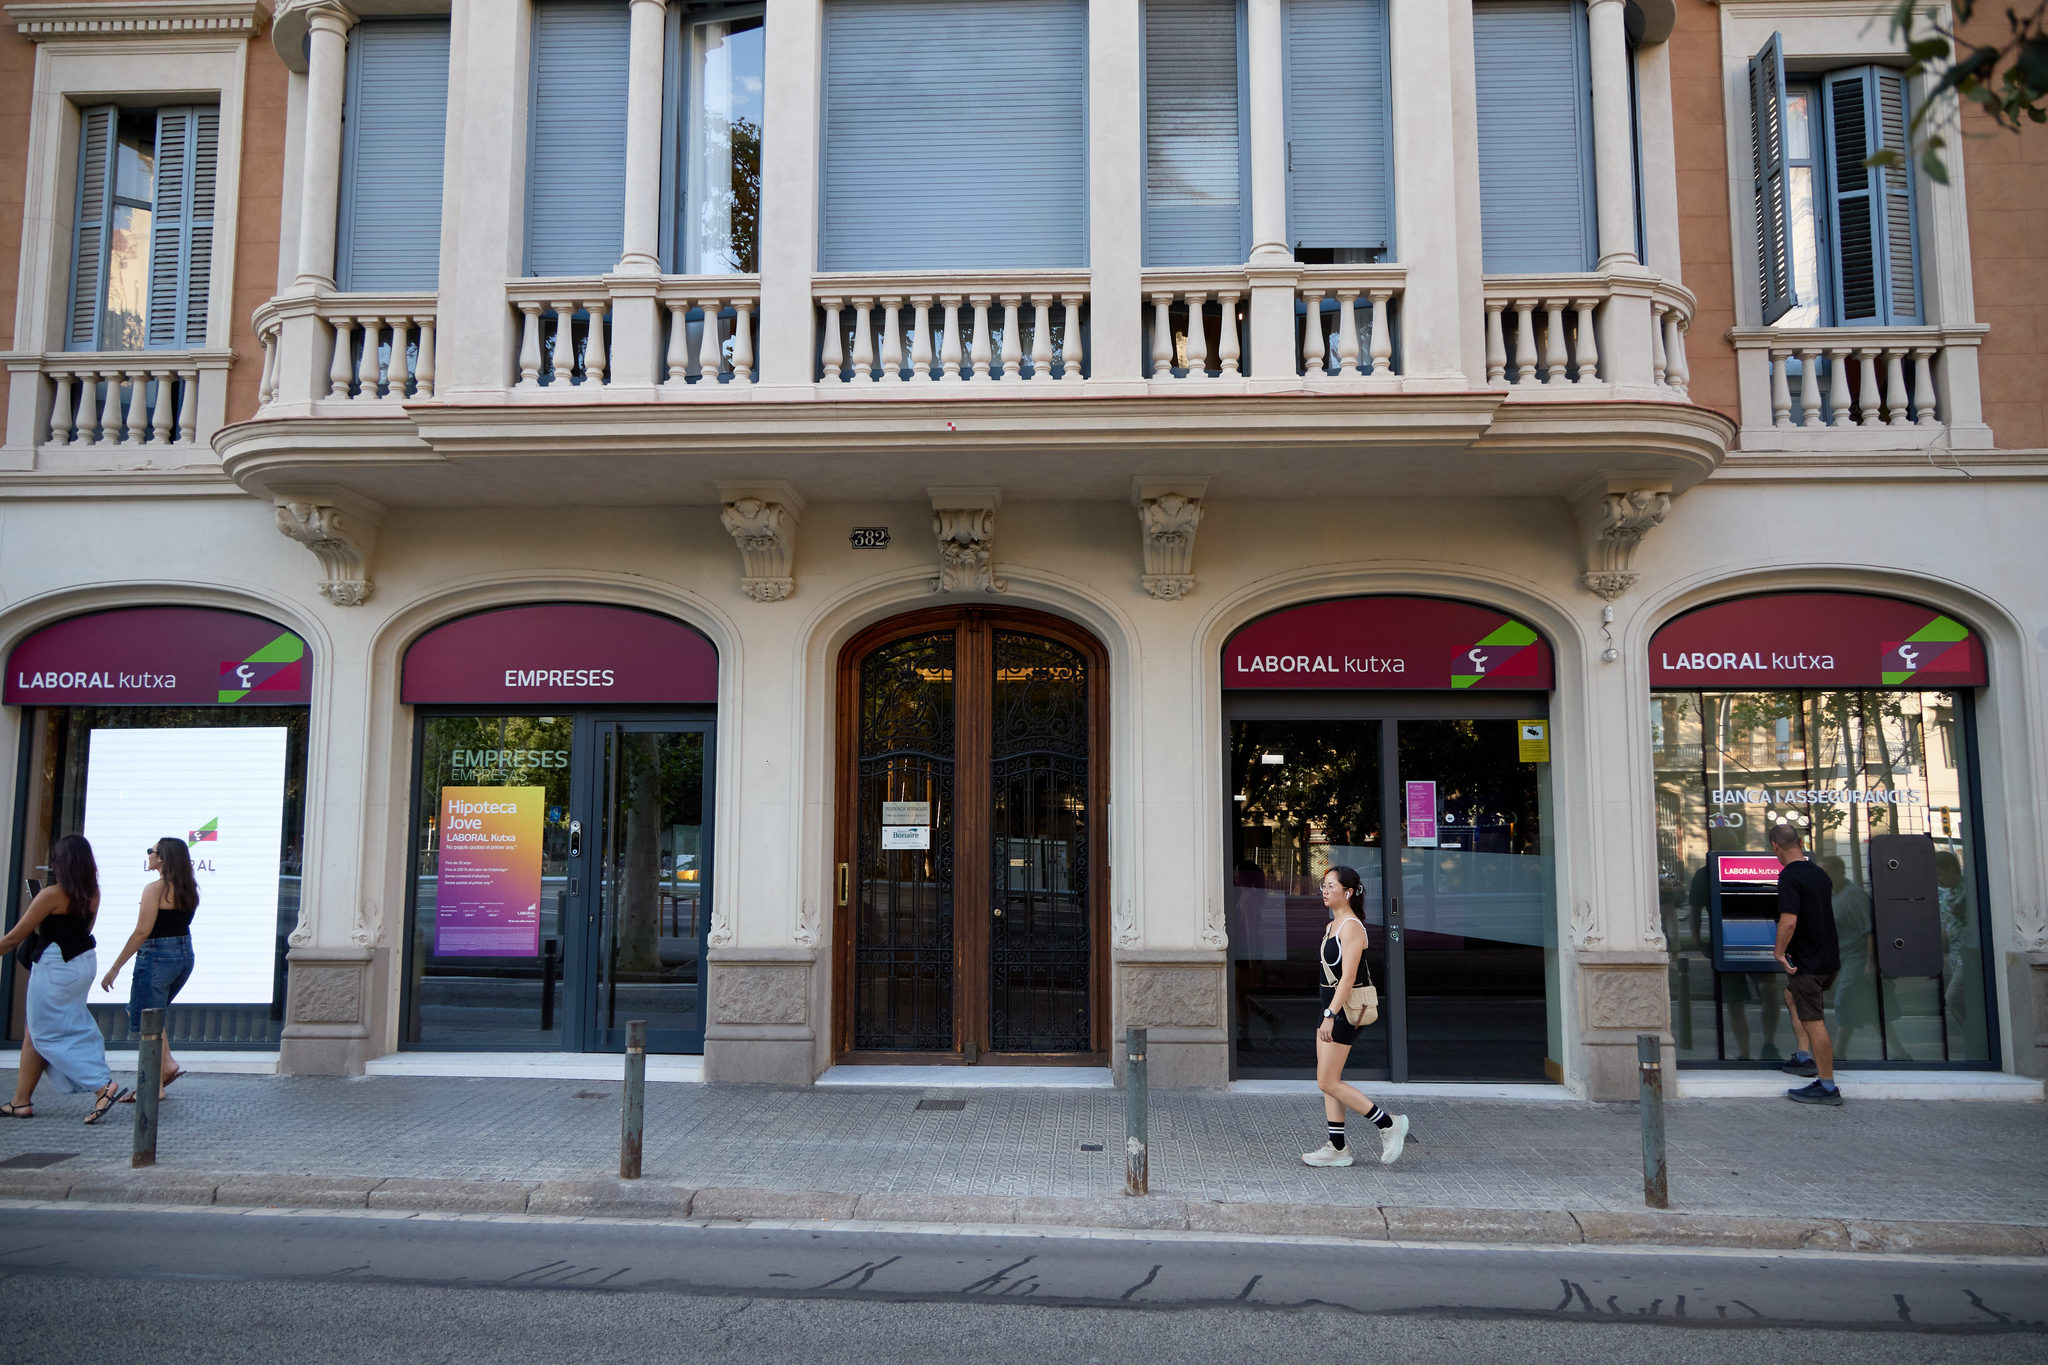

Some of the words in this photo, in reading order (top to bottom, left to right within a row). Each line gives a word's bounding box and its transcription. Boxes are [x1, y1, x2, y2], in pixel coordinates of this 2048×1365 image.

[855, 531, 885, 546] 382
[1237, 655, 1339, 673] LABORAL
[1344, 655, 1405, 673] kutxa
[1662, 652, 1767, 670] LABORAL
[1772, 652, 1835, 670] kutxa
[18, 672, 114, 689] LABORAL
[119, 671, 176, 689] kutxa
[505, 670, 615, 687] EMPRESES
[452, 750, 568, 768] EMPRESES
[451, 768, 528, 781] EMPRESAS
[1712, 789, 1771, 804] BANCA
[1783, 789, 1921, 804] ASSEGURANCES
[448, 800, 517, 816] Hipoteca
[447, 816, 482, 830] Jove
[446, 833, 489, 842] LABORAL
[490, 833, 516, 842] Kutxa
